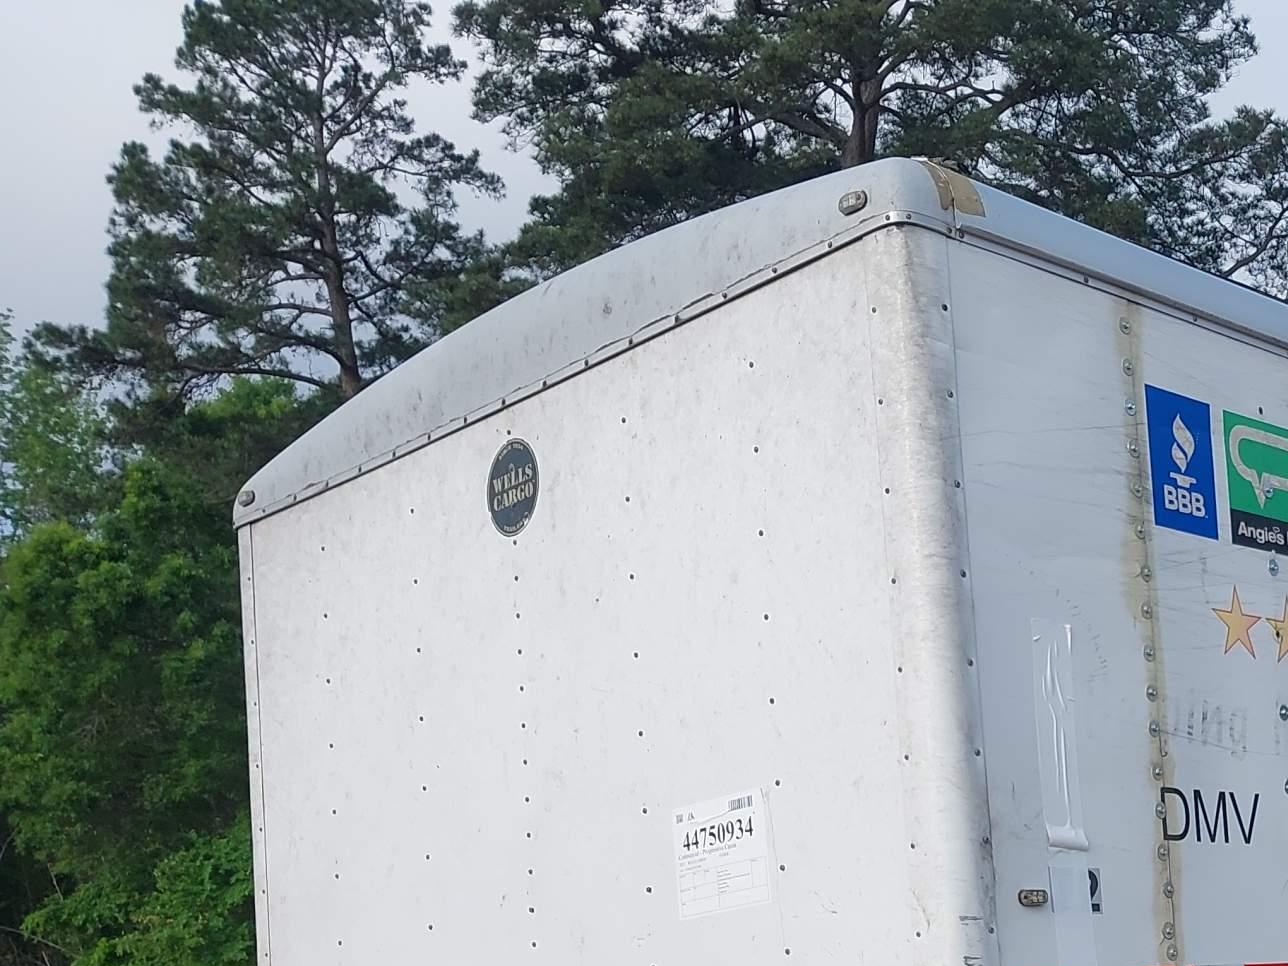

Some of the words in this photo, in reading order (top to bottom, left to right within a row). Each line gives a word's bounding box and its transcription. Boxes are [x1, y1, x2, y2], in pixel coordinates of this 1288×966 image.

[492, 463, 533, 494] WELLS
[493, 481, 534, 512] CARGO
[1163, 484, 1206, 518] BBB
[1160, 786, 1260, 845] DMV
[682, 815, 754, 852] 44750934
